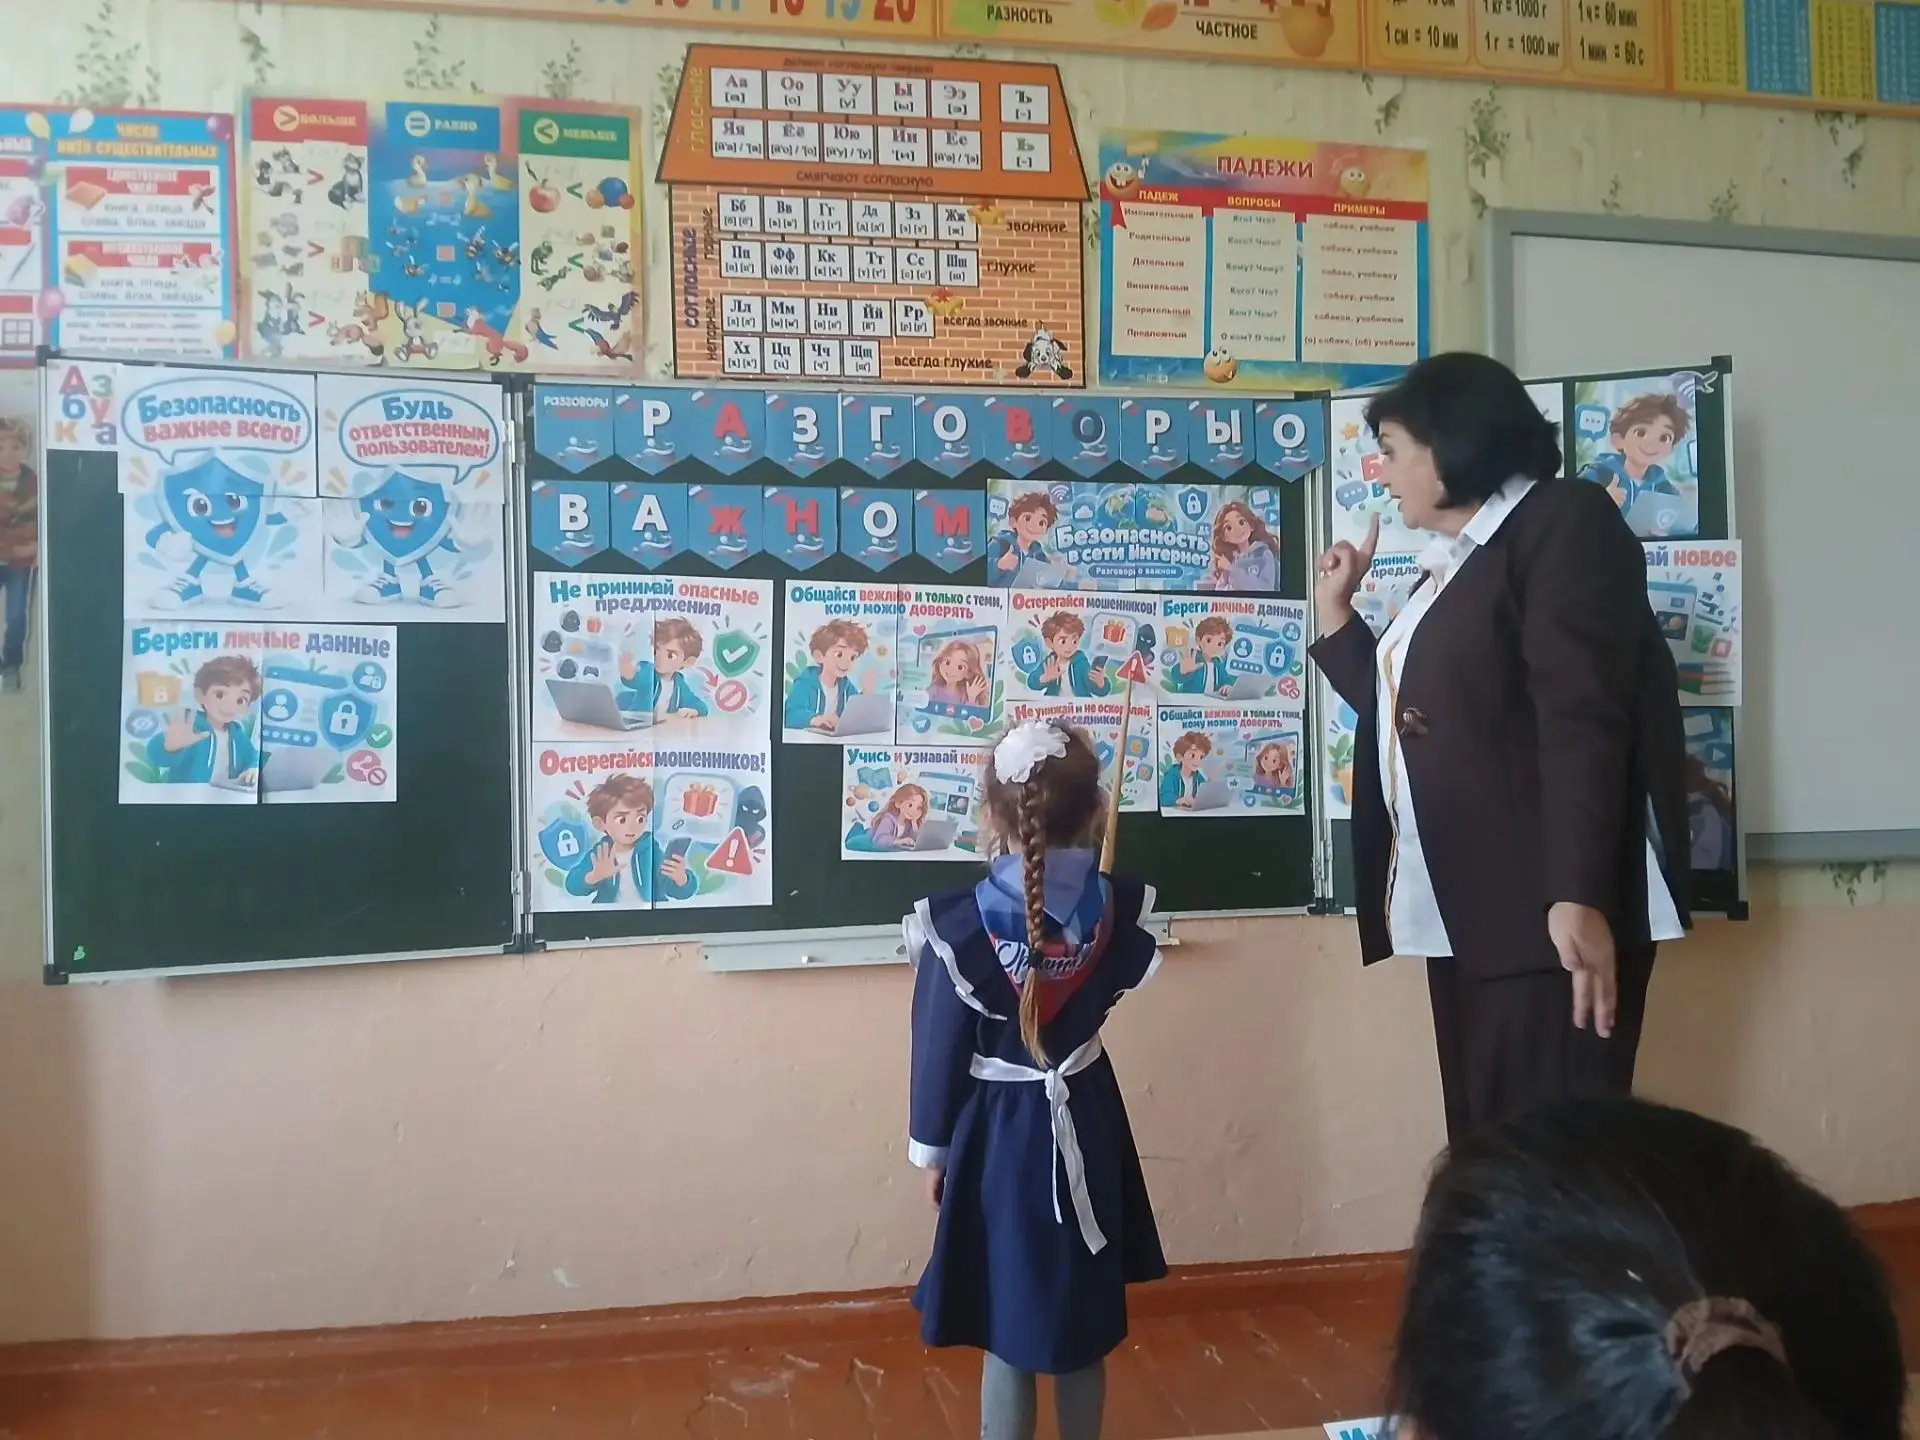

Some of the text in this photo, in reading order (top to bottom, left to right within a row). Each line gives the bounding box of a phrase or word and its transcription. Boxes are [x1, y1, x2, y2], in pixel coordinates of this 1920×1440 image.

[986, 4, 1053, 25] РАЗНОСТЬ
[1515, 0, 1540, 18] 1000
[1542, 5, 1547, 18] г
[1578, 3, 1584, 22] 1
[1586, 11, 1592, 23] ч
[1605, 6, 1617, 24] 60
[1618, 12, 1637, 27] мин
[1194, 20, 1260, 42] ЧАСТНОЕ
[1384, 21, 1391, 44] 1
[1394, 28, 1409, 46] см
[1427, 25, 1440, 48] 10
[1442, 32, 1459, 49] мм
[1485, 31, 1490, 50] 1
[1493, 35, 1499, 50] г
[1520, 35, 1545, 56] 1000
[1547, 41, 1560, 58] мг
[1579, 38, 1585, 59] 1
[1588, 44, 1607, 61] мин
[1624, 41, 1637, 65] 60
[1638, 49, 1644, 66] с
[725, 74, 748, 89] Аа
[780, 76, 804, 90] Оо
[837, 79, 863, 96] Уу
[943, 85, 967, 100] Ээ
[1015, 90, 1032, 104] Ъ
[434, 118, 478, 132] РАВНО
[722, 120, 746, 136] Яя
[782, 122, 805, 138] Ёё
[833, 126, 861, 141] Юю
[892, 129, 918, 144] Ии
[945, 131, 968, 146] Ее
[1216, 156, 1314, 179] ПАДЕЖИ
[1138, 190, 1179, 203] ПАДЕЖ
[1227, 196, 1281, 208] ВОПРОСЫ
[730, 199, 746, 213] Бб
[776, 200, 793, 214] Вв
[819, 202, 835, 217] Гг
[862, 204, 878, 219] Дд
[905, 206, 921, 220] Зз
[1333, 203, 1386, 215] ПРИМЕРЫ
[945, 208, 966, 222] Жж
[1006, 221, 1068, 233] звонкие
[731, 245, 751, 259] Пп
[773, 247, 795, 263] Фф
[817, 249, 837, 263] Кк
[865, 250, 884, 265] Тт
[906, 252, 925, 266] Сс
[945, 254, 967, 268] Шш
[986, 261, 1036, 276] глухие
[730, 300, 752, 314] Лл
[771, 301, 795, 315] Мм
[816, 303, 838, 317] Нн
[862, 303, 884, 320] Йй
[903, 305, 924, 320] Рр
[942, 316, 1028, 328] всегда звонкие
[734, 341, 751, 355] Хх
[771, 342, 791, 357] Цц
[811, 343, 831, 357] Чч
[850, 345, 872, 360] Щщ
[894, 356, 993, 372] всегда глухие
[136, 393, 301, 425] Безопасность
[382, 396, 454, 422] Будь
[143, 418, 302, 444] важнее всего!
[348, 420, 490, 443] ответственным
[355, 438, 490, 460] пользователем!
[1055, 524, 1210, 553] Безопасность
[1067, 543, 1210, 568] в сети Интернет
[1673, 548, 1738, 569] новое
[1145, 567, 1177, 576] важном
[550, 578, 760, 606] Не принимай опасные
[790, 587, 856, 605] Общайся
[915, 591, 923, 602] и
[926, 591, 963, 604] только
[966, 594, 972, 605] с
[973, 595, 1003, 610] теми,
[825, 603, 860, 617] кому
[909, 604, 974, 619] доверять
[1012, 592, 1157, 616] Остерегайся мошенников!
[1163, 600, 1304, 620] Береги личные данные
[131, 626, 391, 659] Береги личные данные
[1014, 703, 1033, 721] Не
[1035, 702, 1074, 720] унижай
[1076, 706, 1082, 714] и
[1084, 703, 1097, 713] не
[1159, 709, 1203, 723] Общайся
[1250, 710, 1276, 719] только
[1182, 719, 1205, 729] кому
[1207, 719, 1238, 728] можно
[540, 748, 766, 776] Остерегайся мошенников!
[847, 747, 993, 765] Учись и узнавай нов
